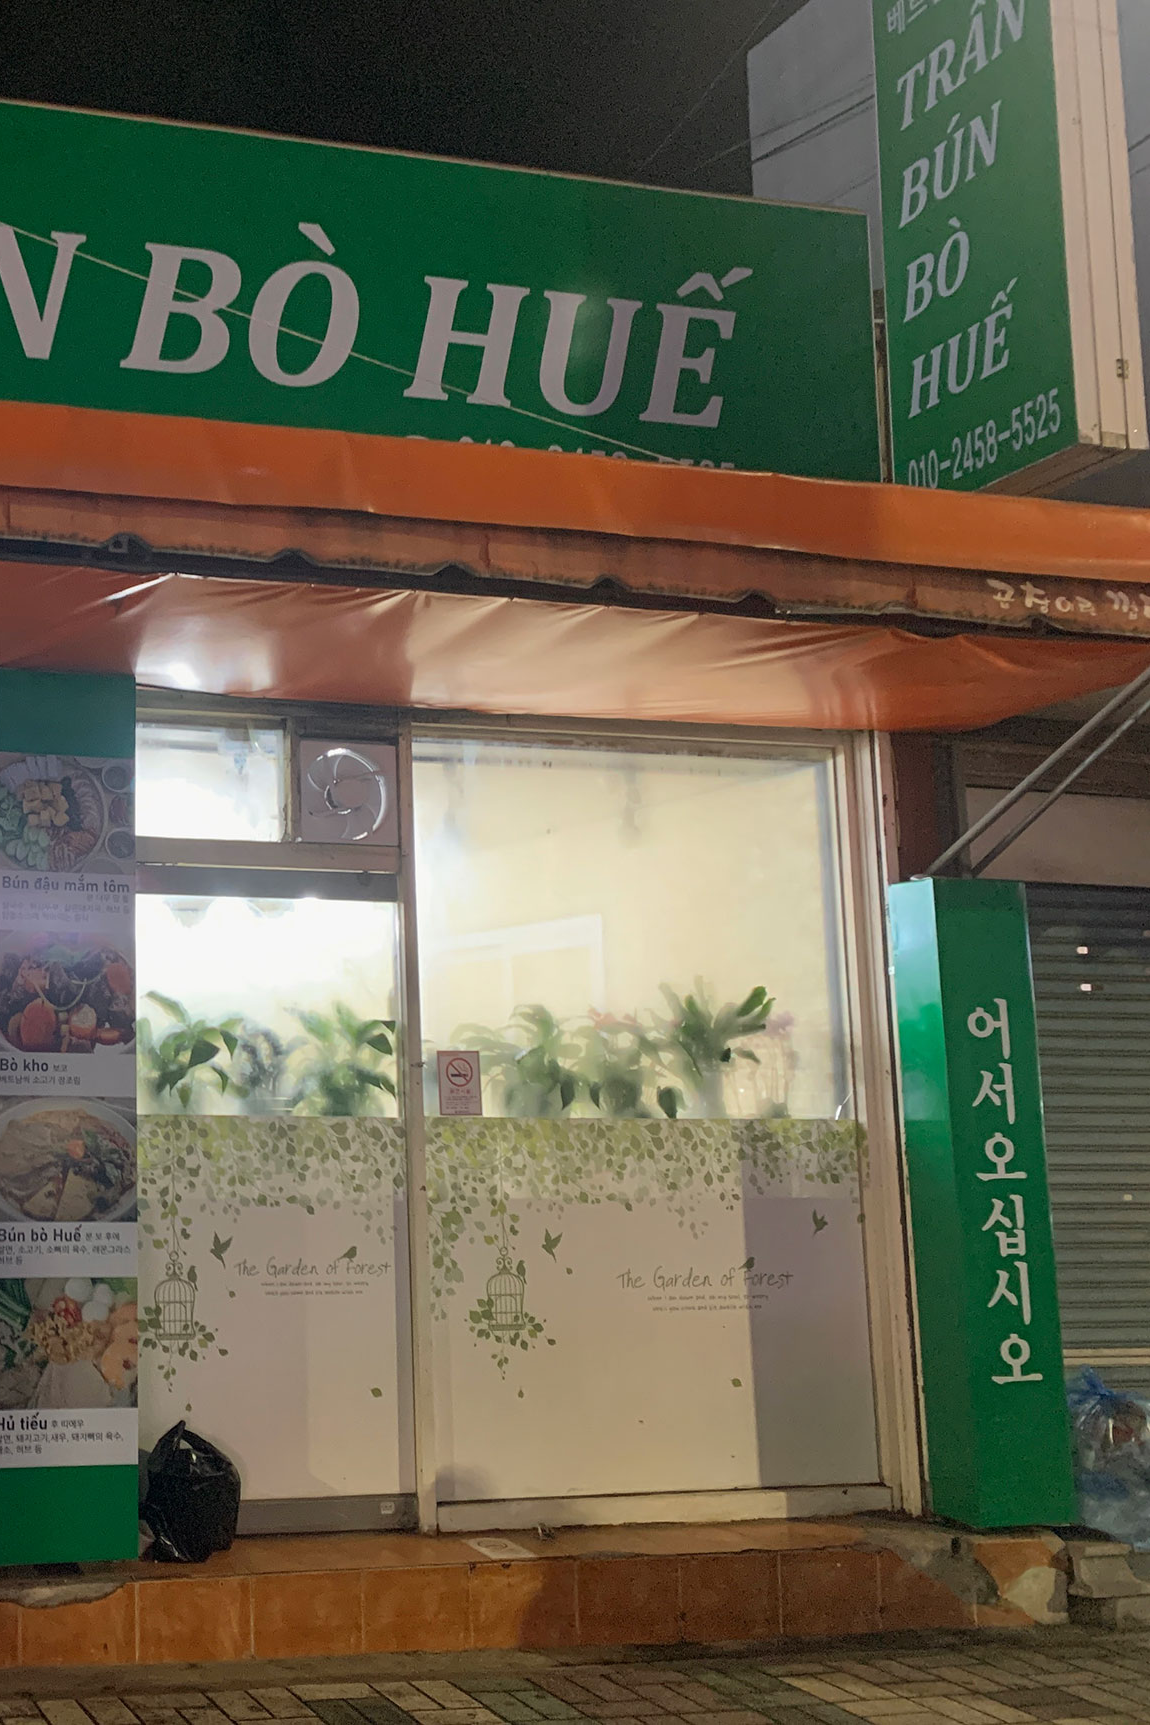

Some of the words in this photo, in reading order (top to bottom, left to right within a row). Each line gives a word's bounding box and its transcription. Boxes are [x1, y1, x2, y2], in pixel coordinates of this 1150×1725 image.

[897, 0, 1025, 131] TRÂN
[897, 100, 1002, 229] BÚN
[903, 217, 970, 323] BÒ
[120, 222, 360, 388] BÒ
[403, 267, 753, 429] HUẾ
[907, 277, 1019, 419] HUẾ
[908, 388, 1061, 489] 010-2458-5525
[2, 875, 29, 889] Bún
[34, 876, 59, 894] đậu
[64, 874, 98, 892] mắm
[103, 879, 130, 893] tôm
[0, 1058, 18, 1071] Bò
[23, 1058, 48, 1072] kho
[31, 1227, 48, 1242] bò
[53, 1223, 82, 1242] Huế
[966, 998, 1044, 1385] 어서오십시오
[234, 1258, 260, 1276] The
[266, 1256, 319, 1278] Garden
[326, 1260, 338, 1276] of
[346, 1261, 392, 1277] Forest
[616, 1268, 646, 1289] The
[653, 1265, 713, 1291] Garden
[720, 1266, 736, 1287] of
[744, 1270, 794, 1289] Forest
[20, 1412, 48, 1431] tiếu
